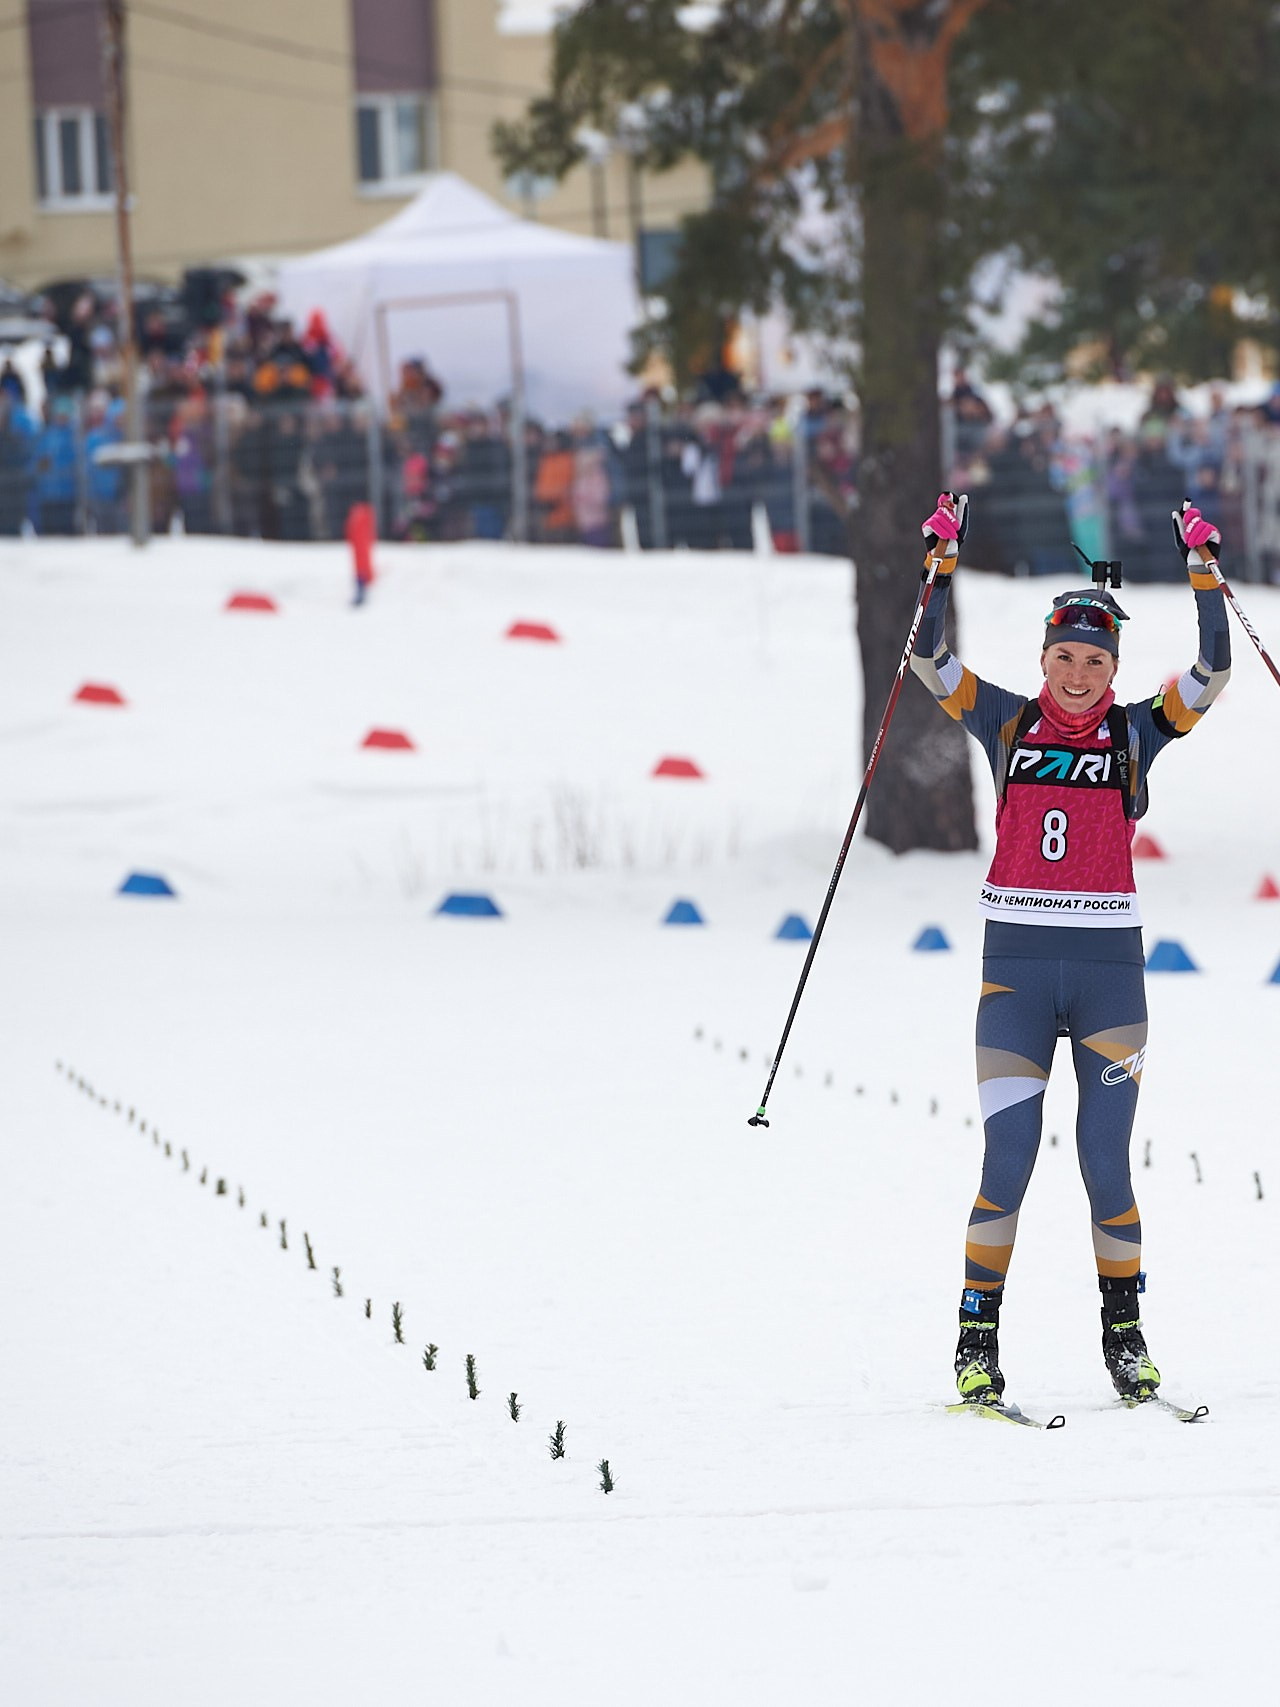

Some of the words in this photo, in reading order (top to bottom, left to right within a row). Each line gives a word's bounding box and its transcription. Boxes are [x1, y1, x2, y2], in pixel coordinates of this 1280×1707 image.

[897, 602, 924, 680] SWIX
[1009, 749, 1111, 782] PARI
[1040, 808, 1069, 862] 8
[1004, 896, 1082, 909] ЧЕМПИОНАТ
[1083, 900, 1131, 910] РОССИИ
